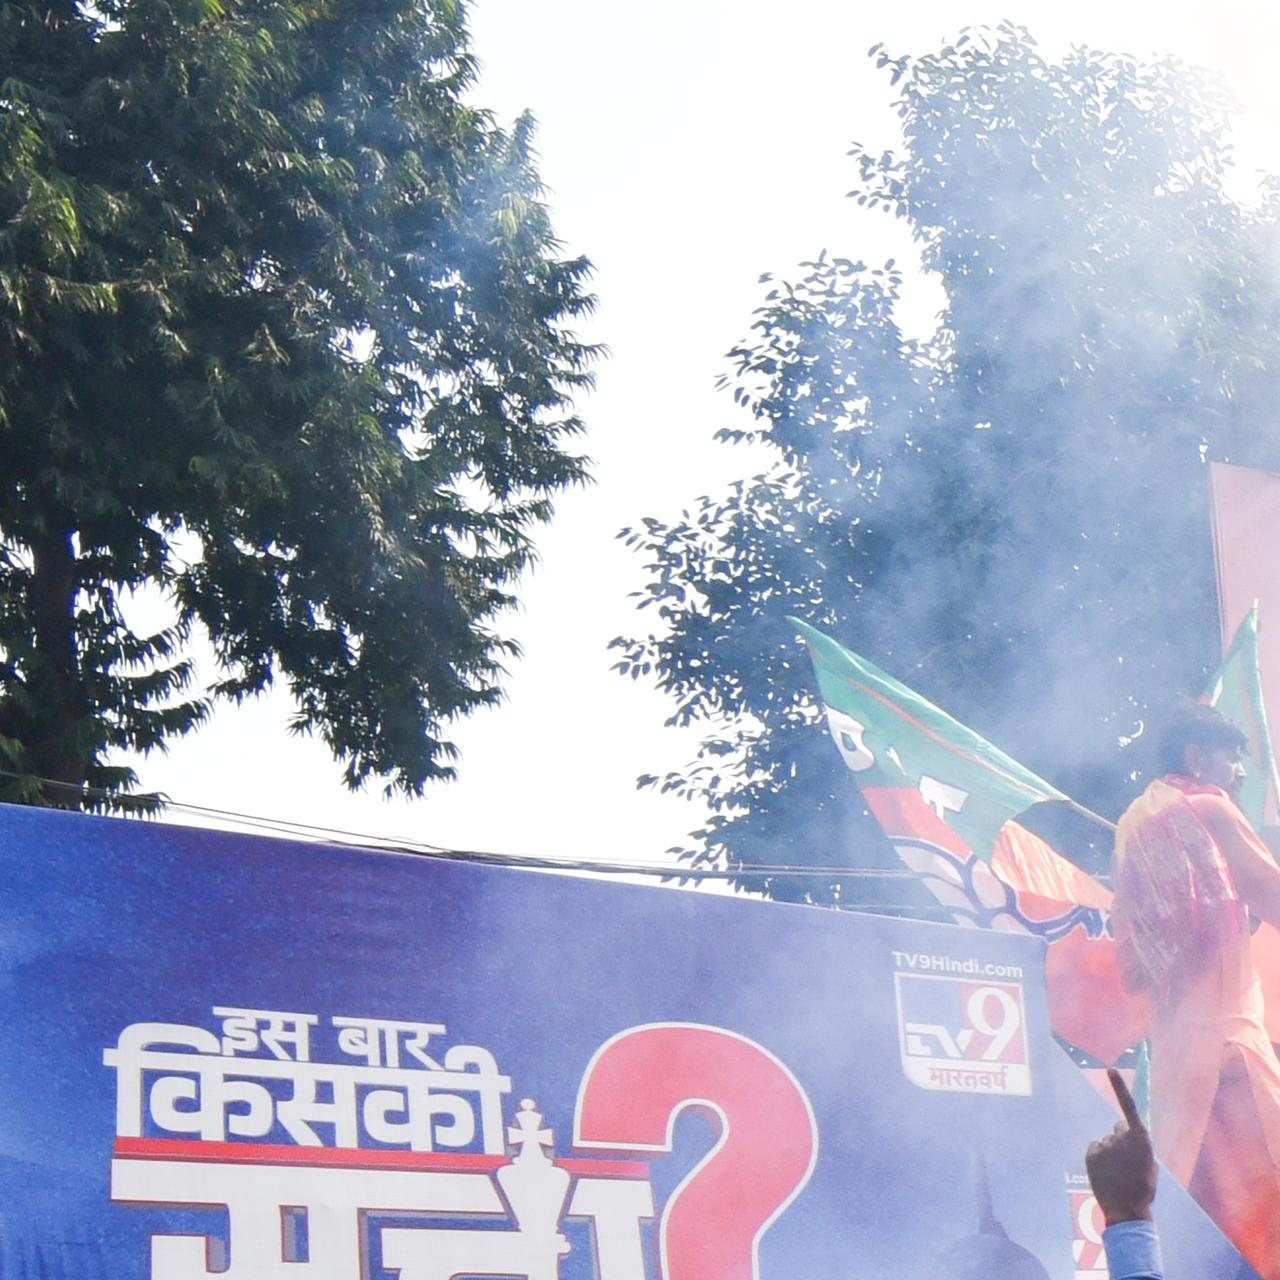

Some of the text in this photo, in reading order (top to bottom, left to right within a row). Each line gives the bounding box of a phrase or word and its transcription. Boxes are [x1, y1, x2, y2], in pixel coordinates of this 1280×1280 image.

[213, 1006, 446, 1071] इस बार
[102, 1021, 512, 1156] किसकी
[928, 1065, 1008, 1091] भारतवर्ष
